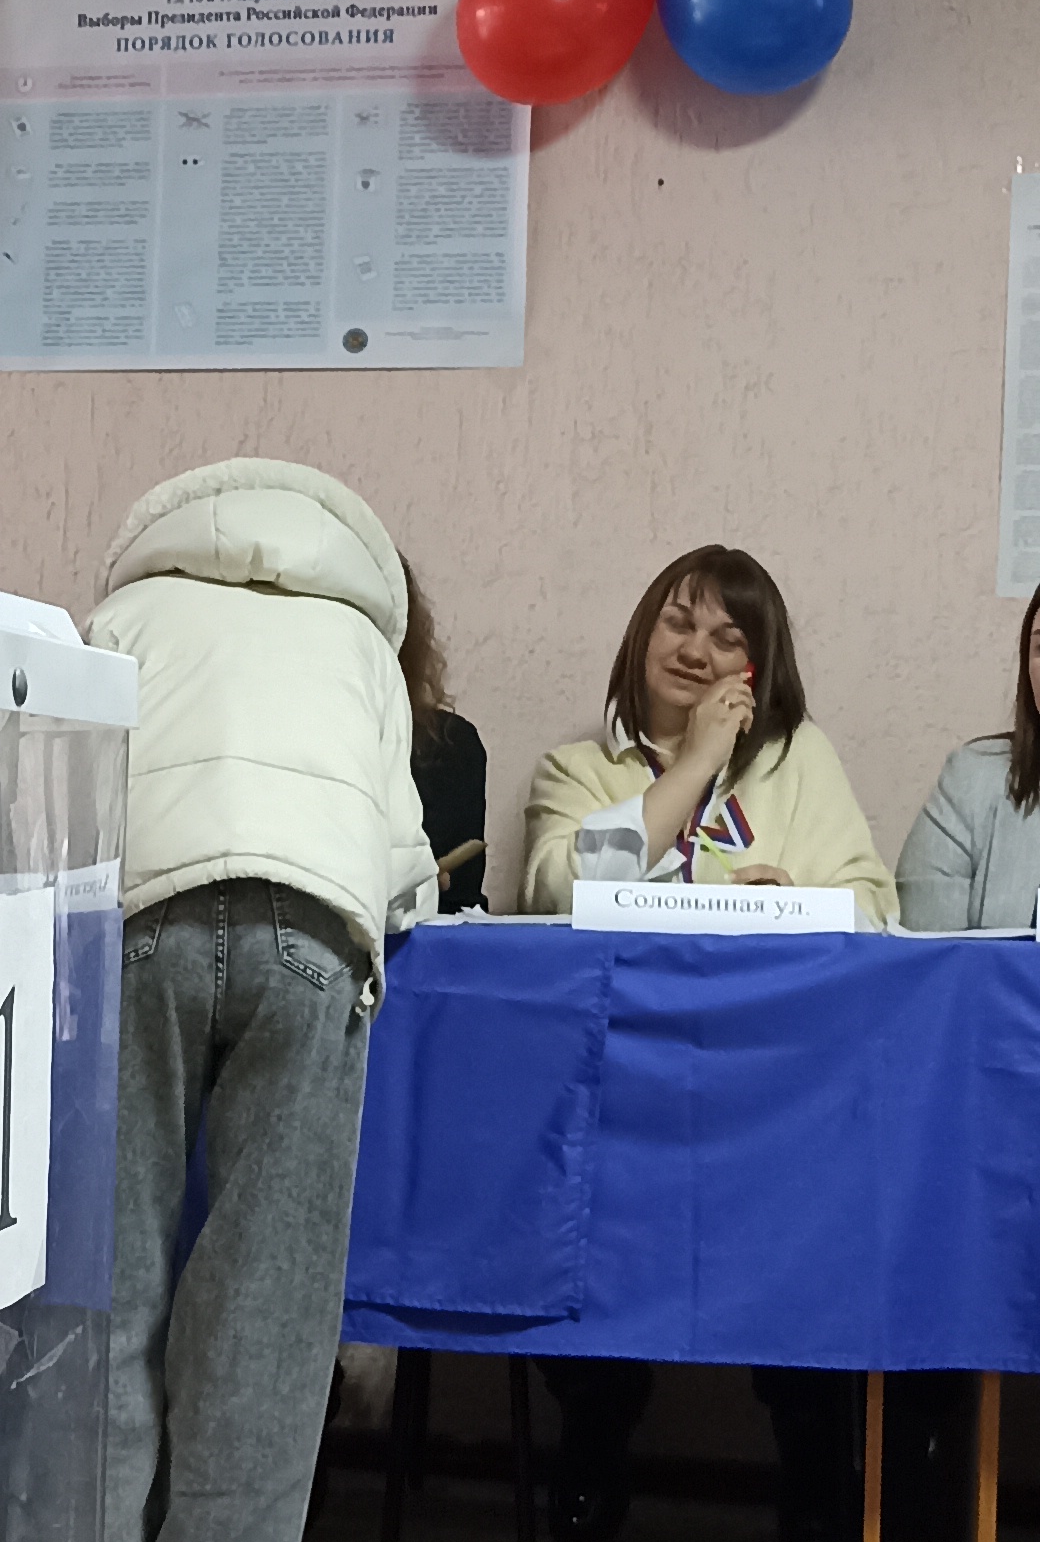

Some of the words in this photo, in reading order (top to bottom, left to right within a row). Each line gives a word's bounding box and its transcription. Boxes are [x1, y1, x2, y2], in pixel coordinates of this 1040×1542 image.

[77, 12, 143, 30] Выборы
[147, 10, 241, 28] Президента
[246, 5, 341, 22] Российской
[345, 3, 438, 21] Федерации
[116, 33, 218, 53] ПОРЯДОК
[226, 28, 395, 49] ГОЛОСОВАНИЯ
[614, 888, 766, 914] Соловьиная
[773, 899, 810, 921] ул.
